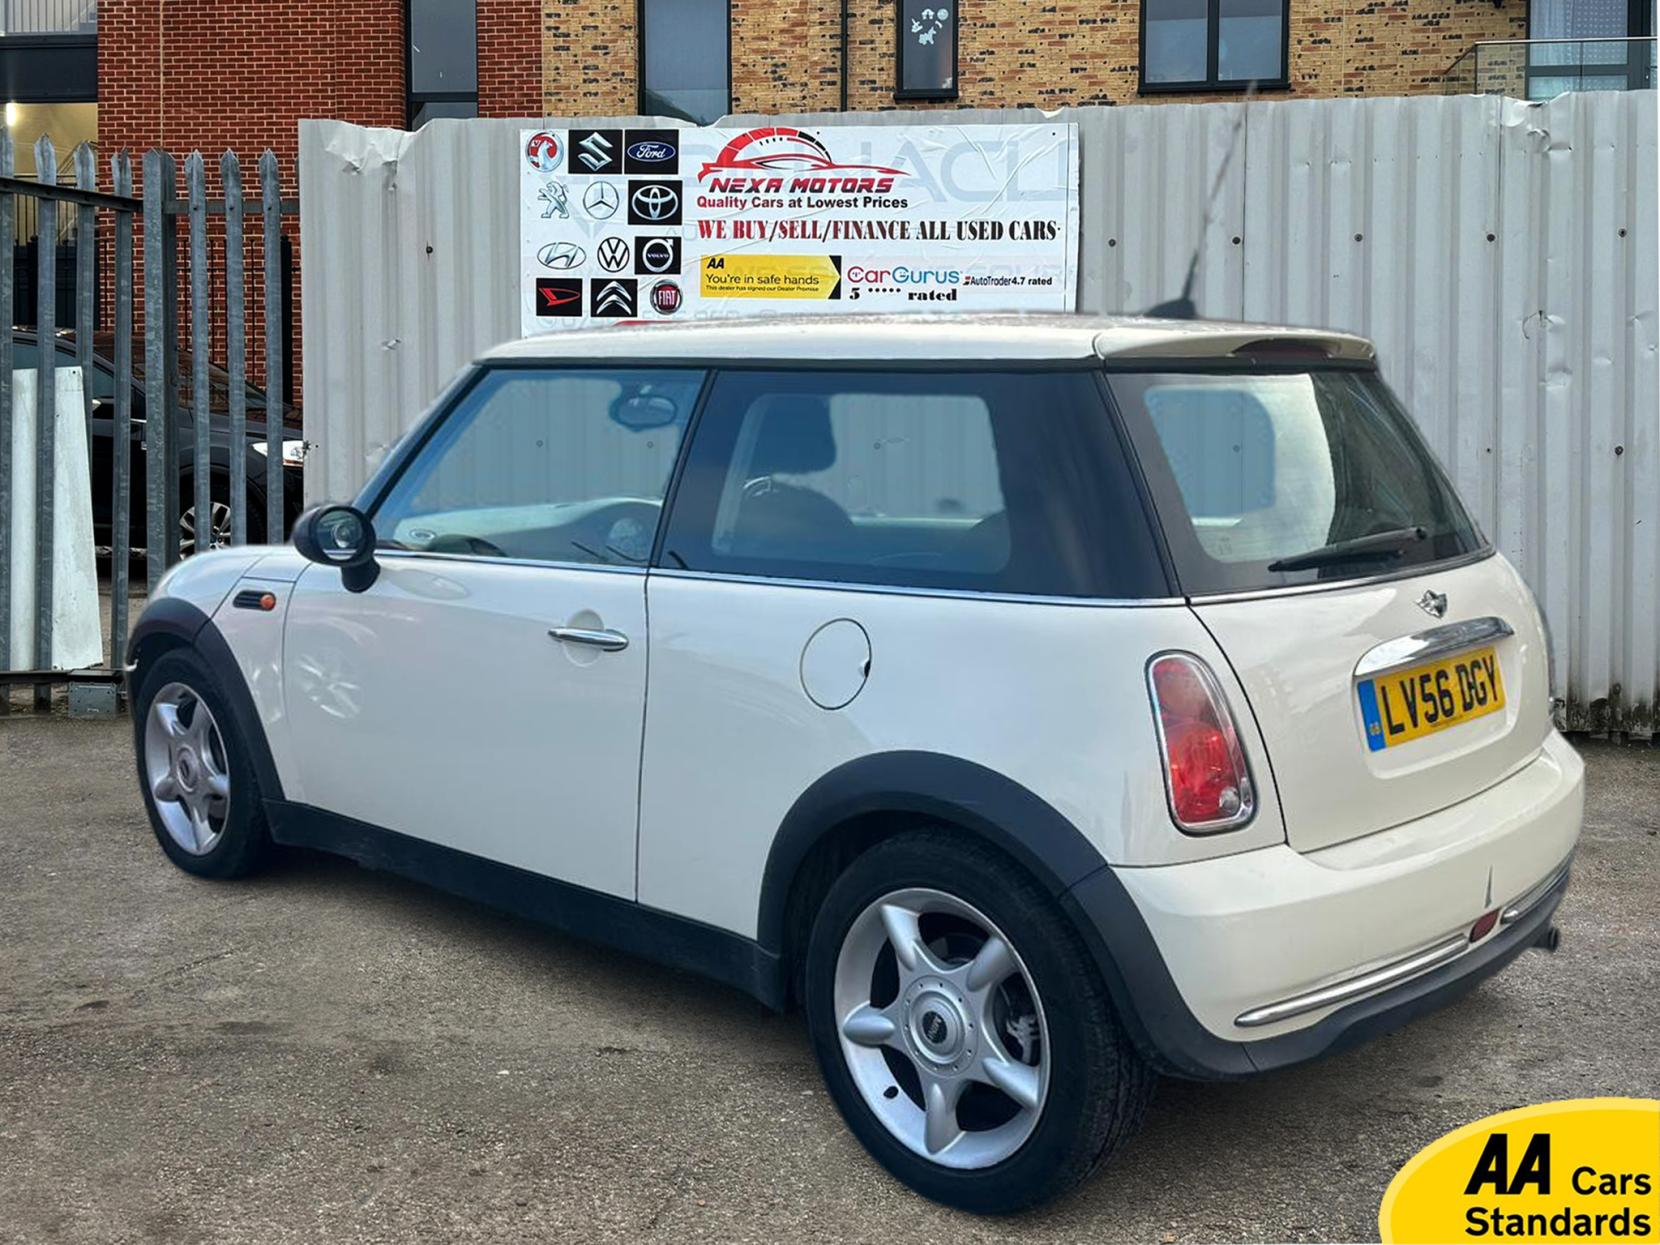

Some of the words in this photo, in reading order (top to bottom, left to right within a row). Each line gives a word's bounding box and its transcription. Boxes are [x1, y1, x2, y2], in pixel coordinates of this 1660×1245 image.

[636, 144, 666, 158] Ford
[709, 177, 784, 193] NEXA
[789, 177, 895, 193] MOTORS
[697, 195, 747, 210] Quality
[751, 196, 784, 208] Cars
[788, 196, 802, 208] at
[807, 196, 858, 208] Lowest
[863, 196, 908, 208] Prices
[697, 219, 727, 240] WE
[916, 220, 951, 240] ALL
[957, 220, 1004, 241] USED
[1009, 220, 1057, 241] CARS
[706, 257, 725, 269] AA
[706, 274, 741, 284] You're
[744, 273, 754, 284] in
[757, 274, 781, 285] safe
[784, 274, 820, 285] hands
[847, 266, 960, 284] CarGurus
[1027, 277, 1053, 286] rated
[658, 290, 676, 306] FIAT
[849, 287, 860, 300] 5
[908, 288, 957, 301] rated
[1381, 668, 1455, 736] LV56
[1455, 655, 1498, 712] DGY
